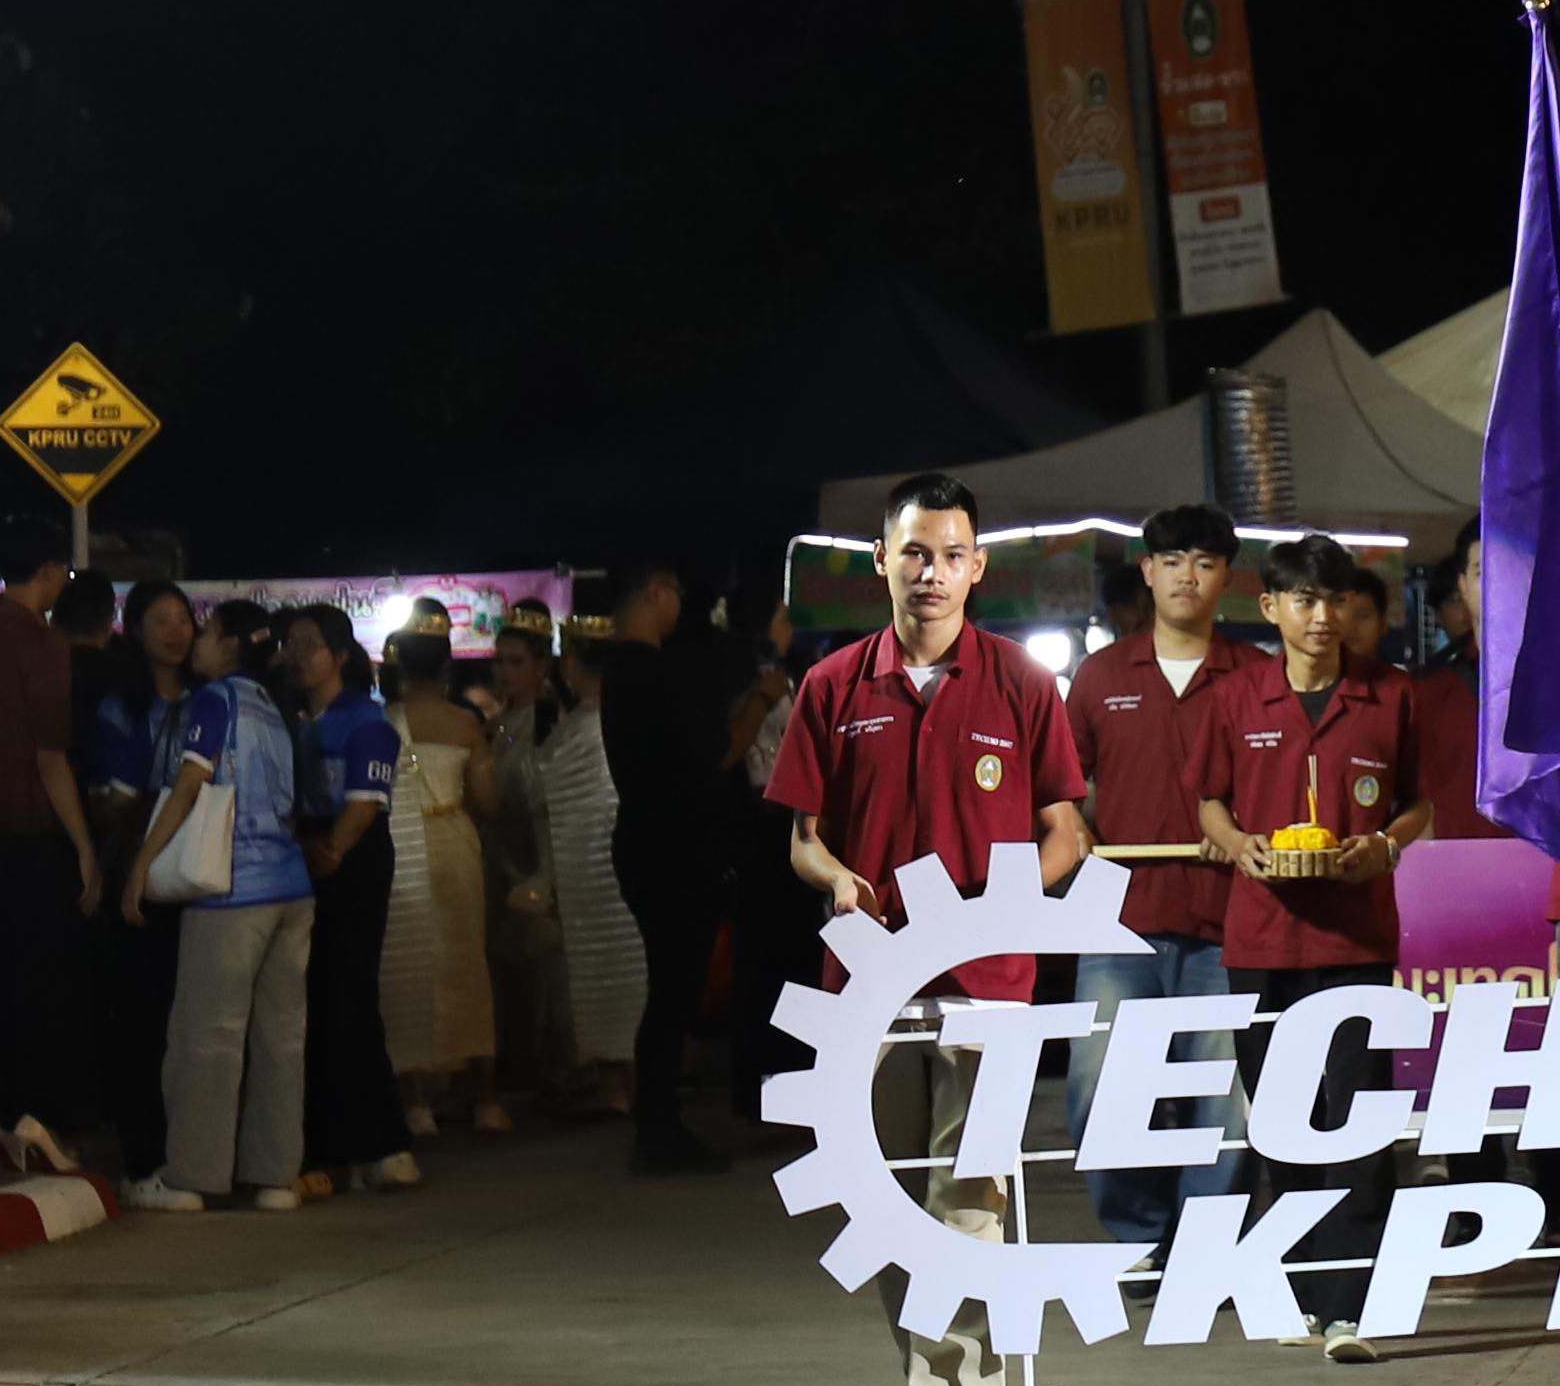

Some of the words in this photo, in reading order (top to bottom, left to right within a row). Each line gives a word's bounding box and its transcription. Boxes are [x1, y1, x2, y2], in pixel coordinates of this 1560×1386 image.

[1054, 204, 1132, 232] KPRU
[27, 429, 78, 448] KPRU
[83, 429, 132, 448] CCTV
